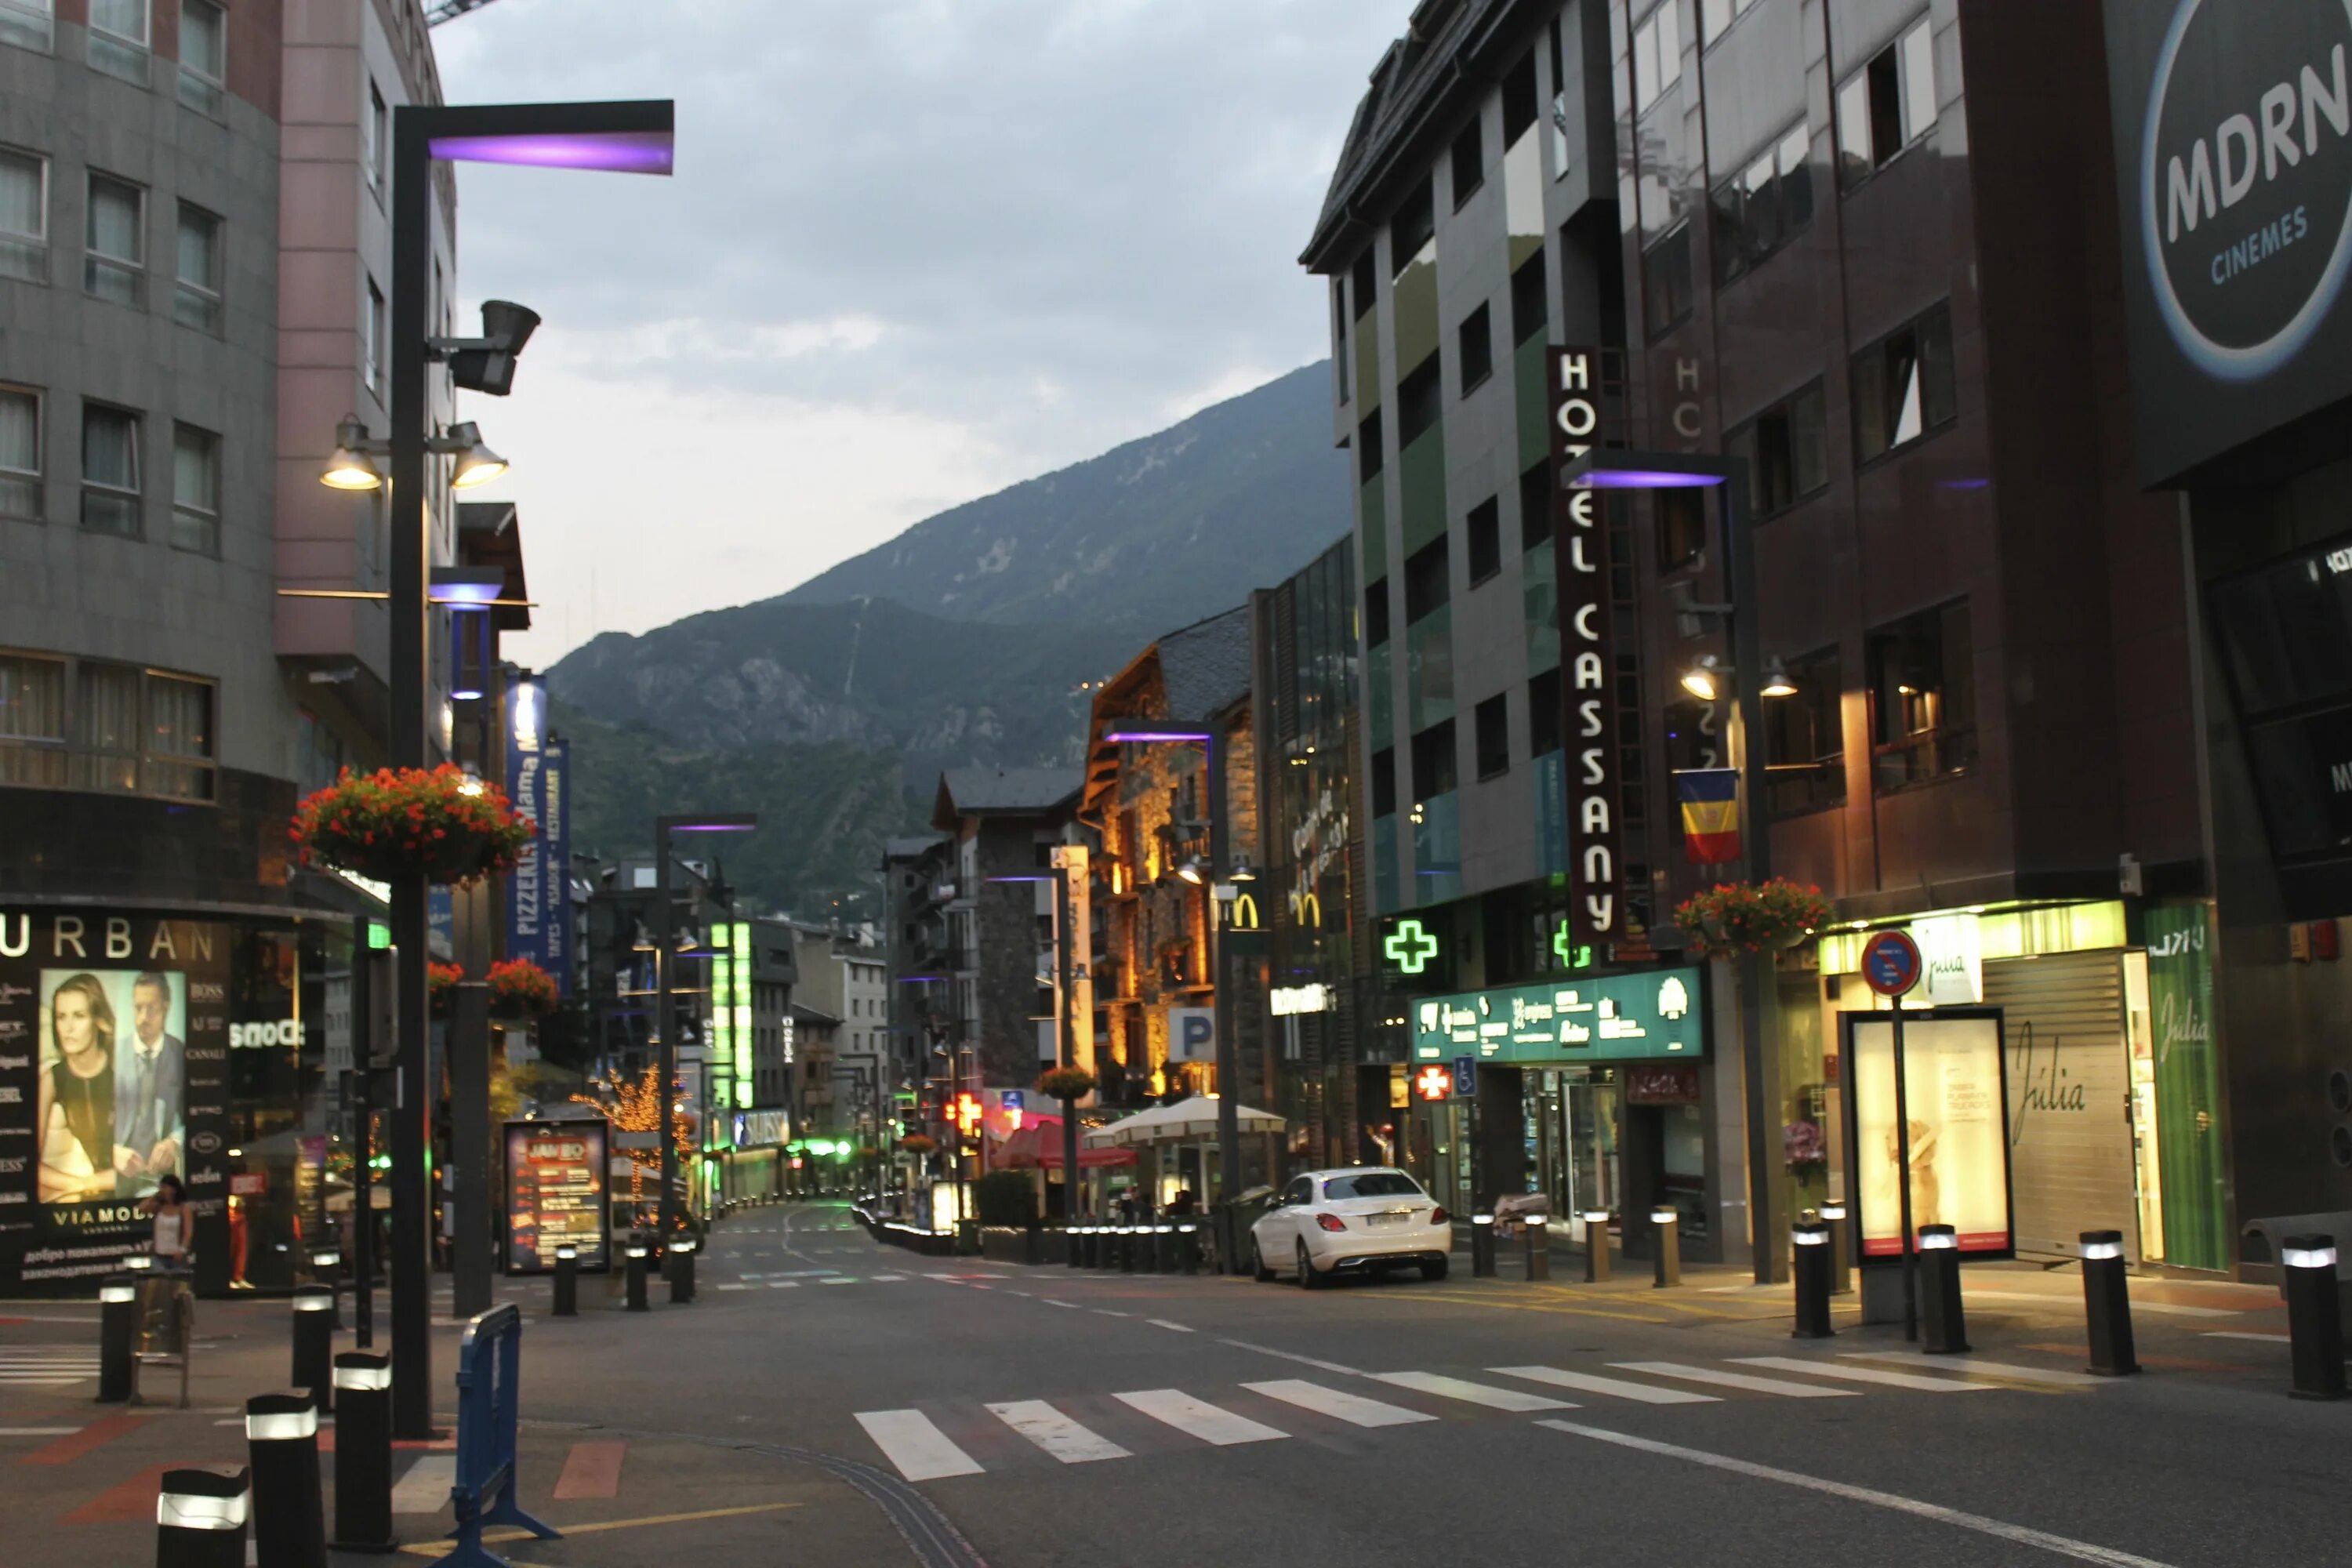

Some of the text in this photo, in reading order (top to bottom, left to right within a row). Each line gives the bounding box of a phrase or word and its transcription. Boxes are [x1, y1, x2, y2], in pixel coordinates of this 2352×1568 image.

[2168, 43, 2350, 244] MDRN
[2211, 205, 2308, 285] CINEMES
[0, 913, 213, 962] URBAN
[1183, 1016, 1213, 1056] P
